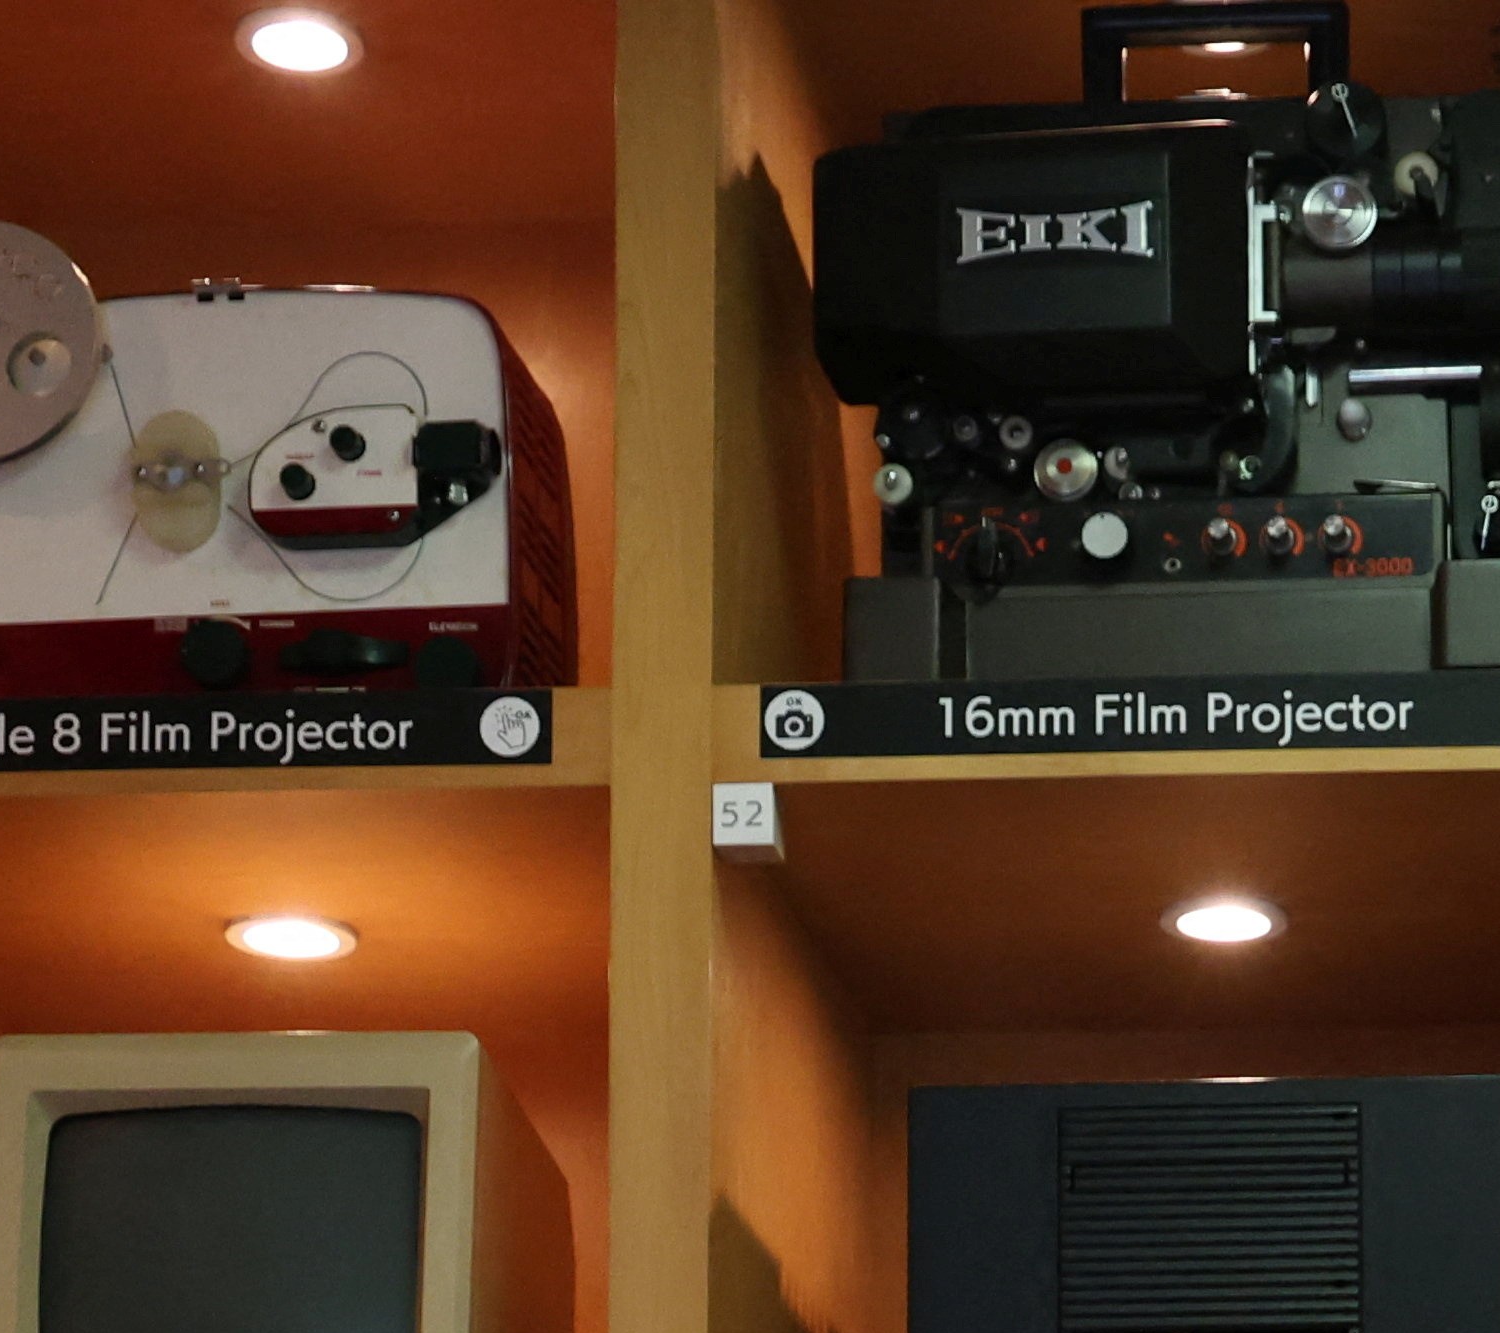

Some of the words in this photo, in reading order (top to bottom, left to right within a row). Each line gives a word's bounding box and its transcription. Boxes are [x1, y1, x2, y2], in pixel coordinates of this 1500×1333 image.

[956, 199, 1155, 266] EIKI
[52, 711, 83, 754] 8
[101, 709, 193, 753] Film
[210, 709, 414, 766] Projector
[937, 694, 1076, 740] 16mm
[1095, 692, 1188, 736] Film
[1207, 690, 1415, 747] Projector
[721, 802, 764, 829] 52
